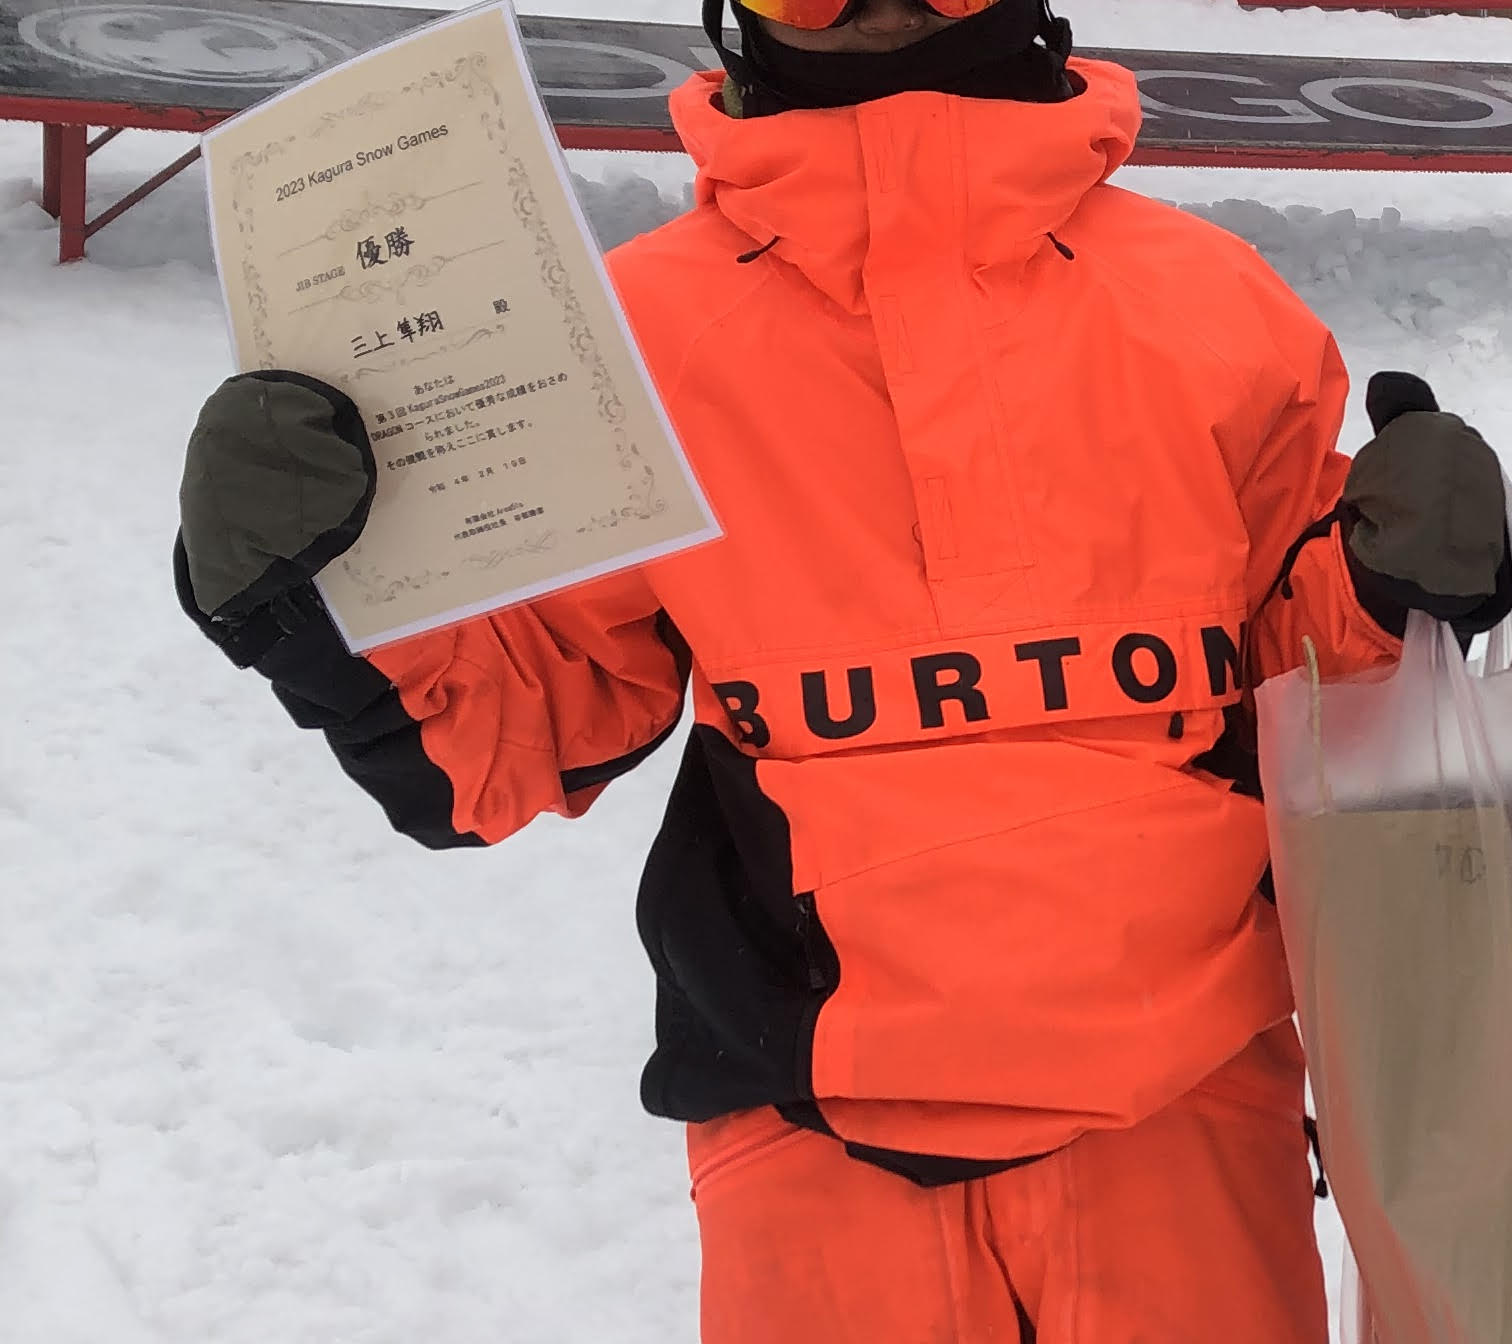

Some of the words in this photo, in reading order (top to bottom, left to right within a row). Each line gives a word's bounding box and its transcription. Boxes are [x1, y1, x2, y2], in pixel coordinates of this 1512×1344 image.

[275, 177, 305, 202] 2023
[307, 159, 353, 187] Kagura
[356, 144, 393, 167] Snow
[397, 124, 449, 151] Games
[355, 225, 415, 270] 優勝
[296, 278, 312, 292] JIB
[312, 265, 346, 286] STAGE
[492, 299, 511, 314] 殿
[413, 375, 456, 396] あなたは
[711, 620, 1248, 749] BURTON
